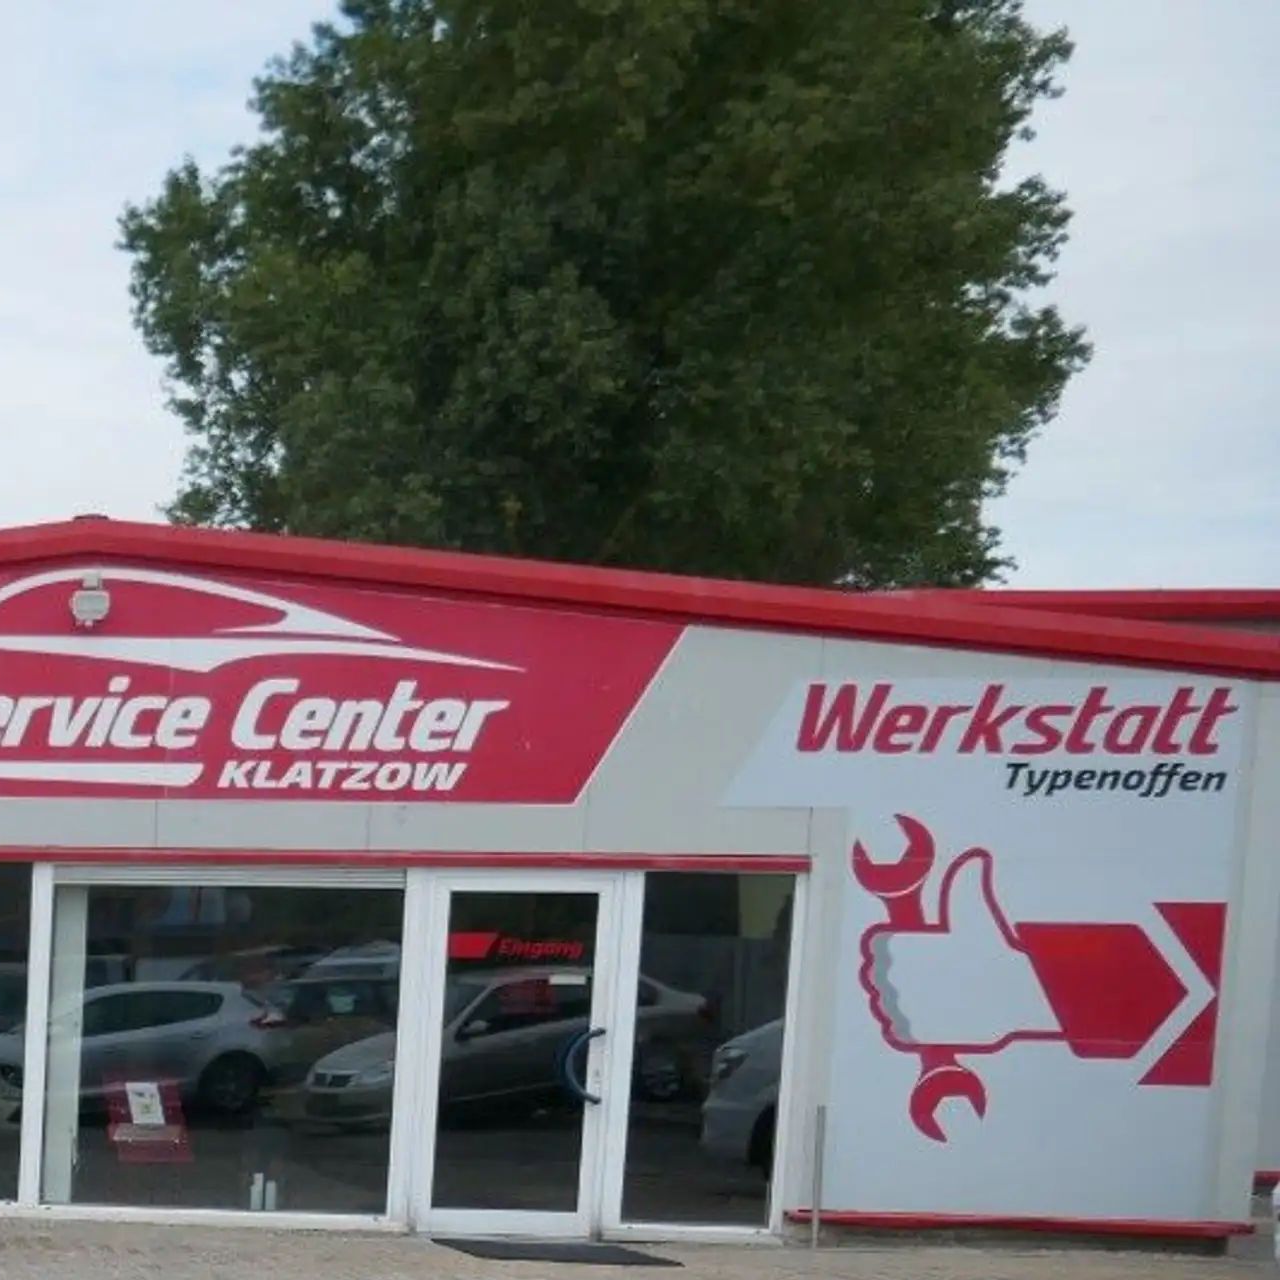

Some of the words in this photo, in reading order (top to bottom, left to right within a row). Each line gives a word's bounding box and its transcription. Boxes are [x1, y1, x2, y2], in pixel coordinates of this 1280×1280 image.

[230, 677, 511, 752] Center
[795, 682, 1240, 756] Werkstatt
[216, 760, 468, 791] KLATZOW
[1003, 761, 1228, 798] Typenoffen
[497, 937, 583, 960] Eingang
